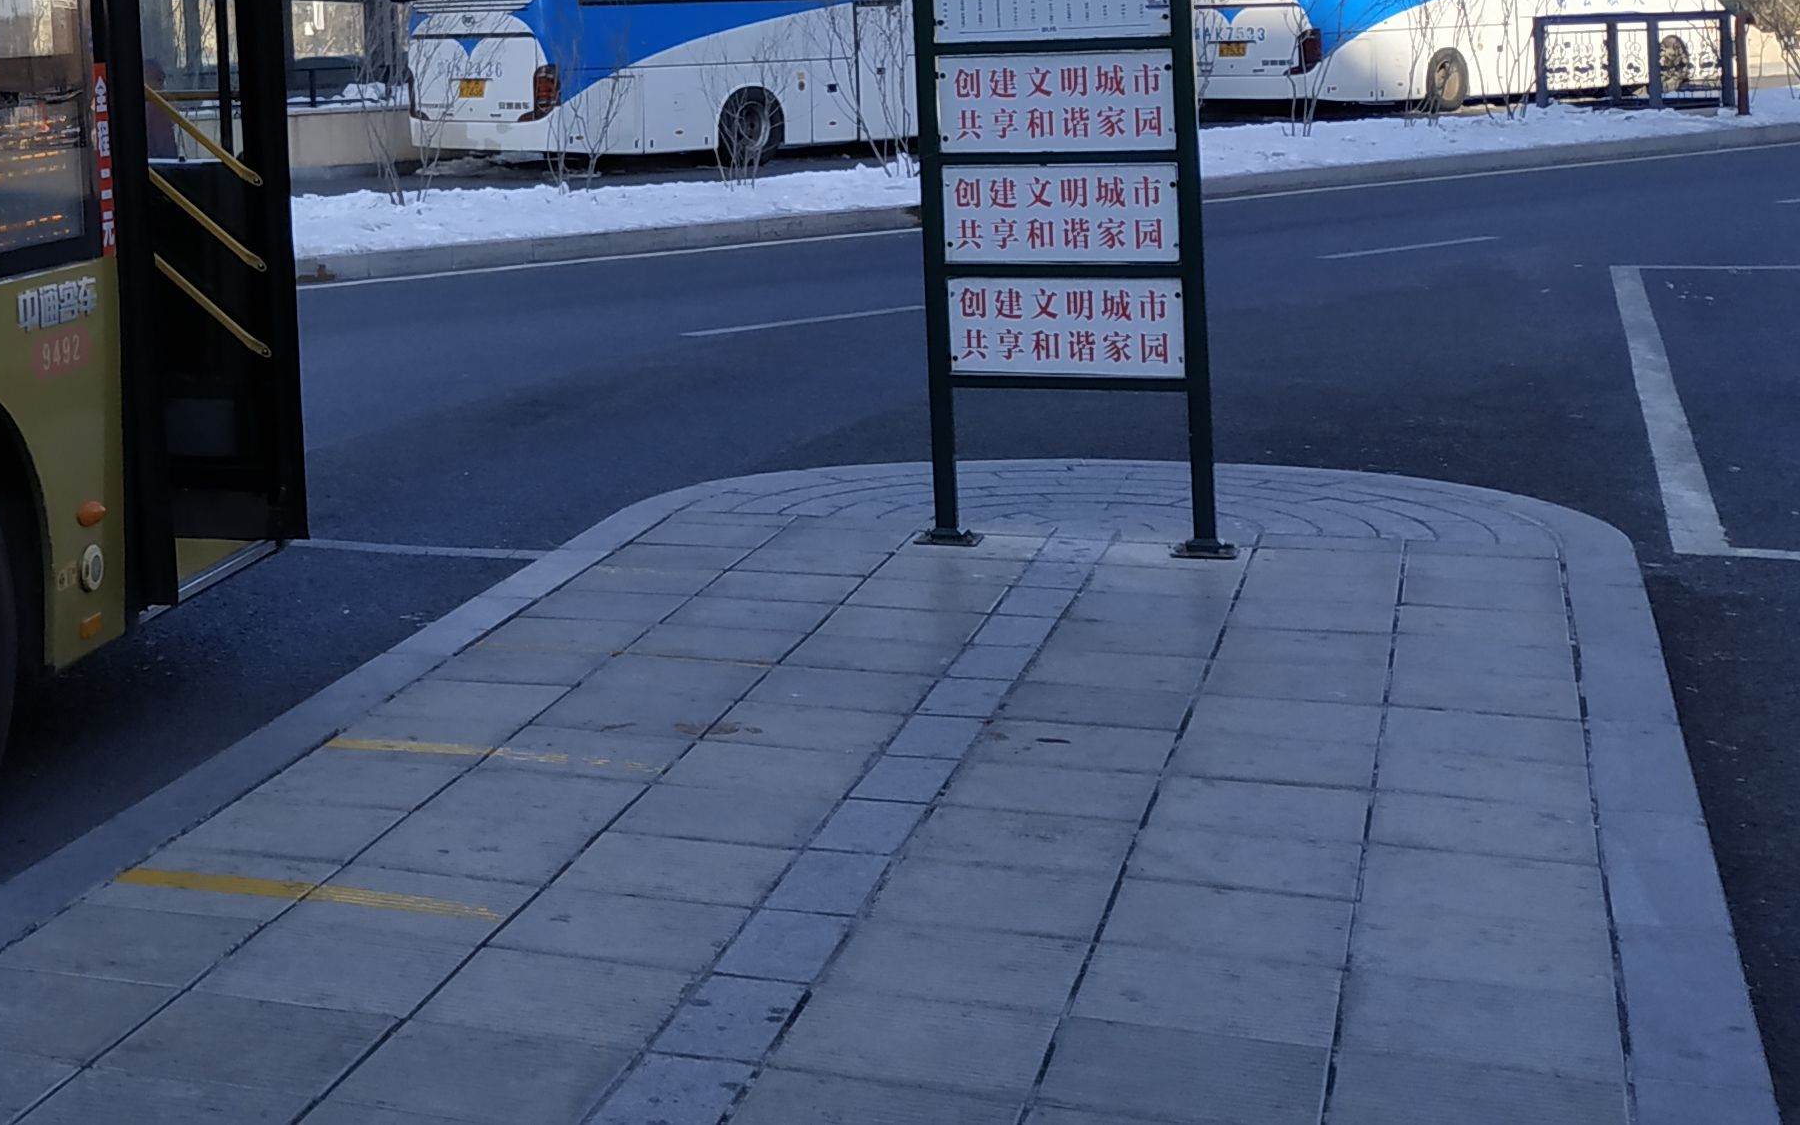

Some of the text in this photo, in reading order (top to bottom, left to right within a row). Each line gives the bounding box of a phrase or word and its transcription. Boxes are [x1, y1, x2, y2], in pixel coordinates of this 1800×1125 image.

[954, 63, 1162, 100] 创建文明城市
[955, 105, 1163, 142] 共享和谐家园
[954, 176, 1162, 210] 创建文明城市
[955, 217, 1163, 252] 共享和谐家园
[16, 276, 98, 332] 中通客车
[959, 287, 1168, 322] 创建文明城市
[42, 334, 81, 371] 9492
[961, 328, 1169, 364] 共享和谐家园
